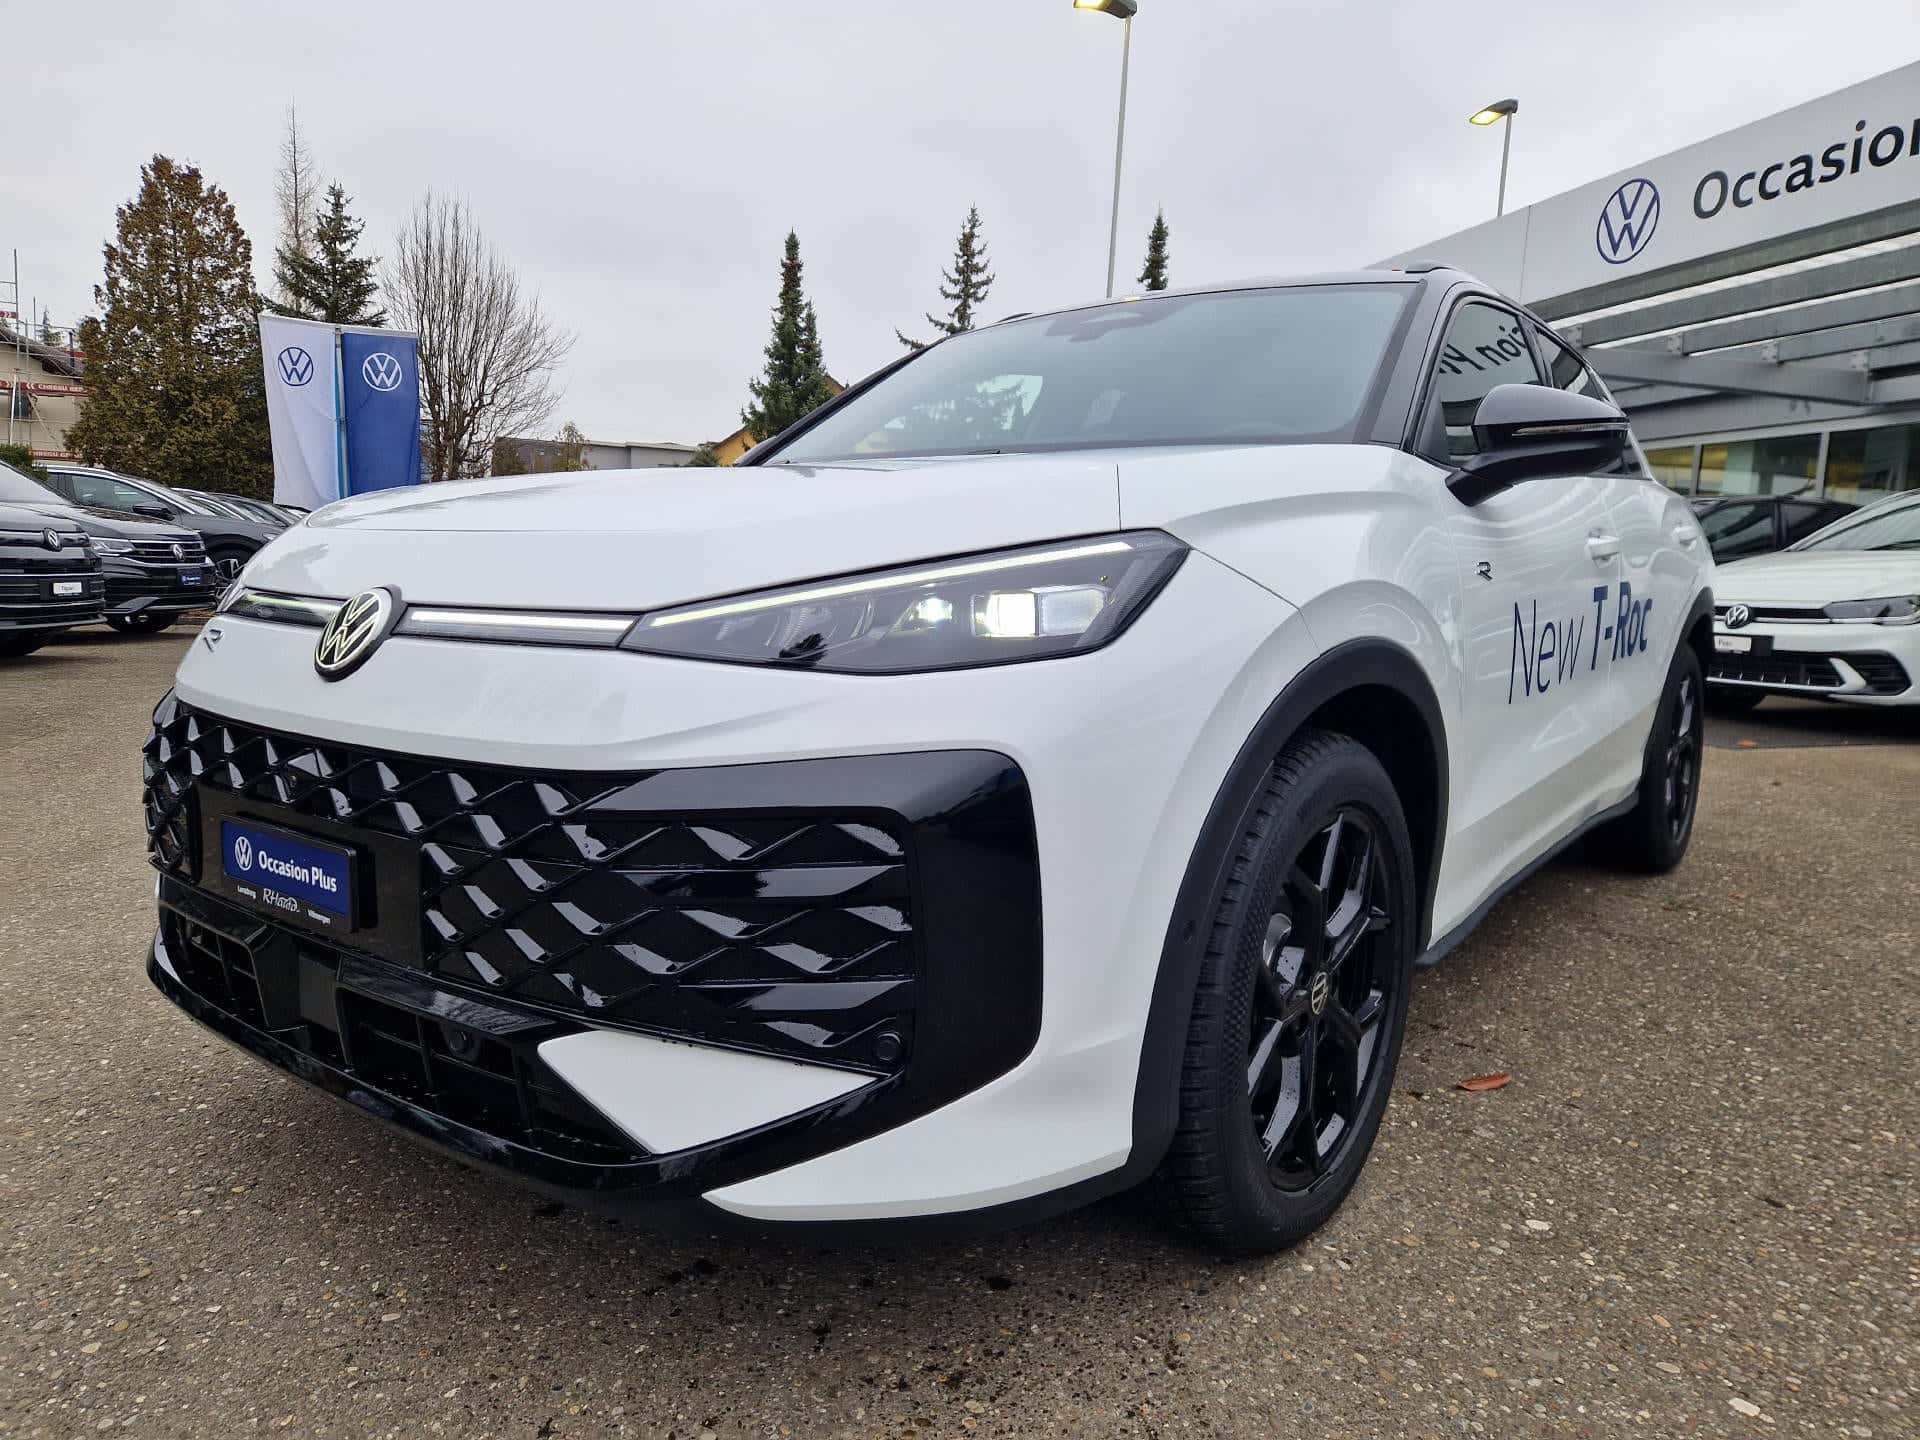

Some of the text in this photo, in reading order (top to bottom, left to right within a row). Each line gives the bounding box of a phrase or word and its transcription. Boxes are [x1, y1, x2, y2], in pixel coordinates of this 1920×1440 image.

[1508, 581, 1653, 704] New T-Roc
[258, 850, 310, 884] Occasion
[311, 865, 338, 893] Plus
